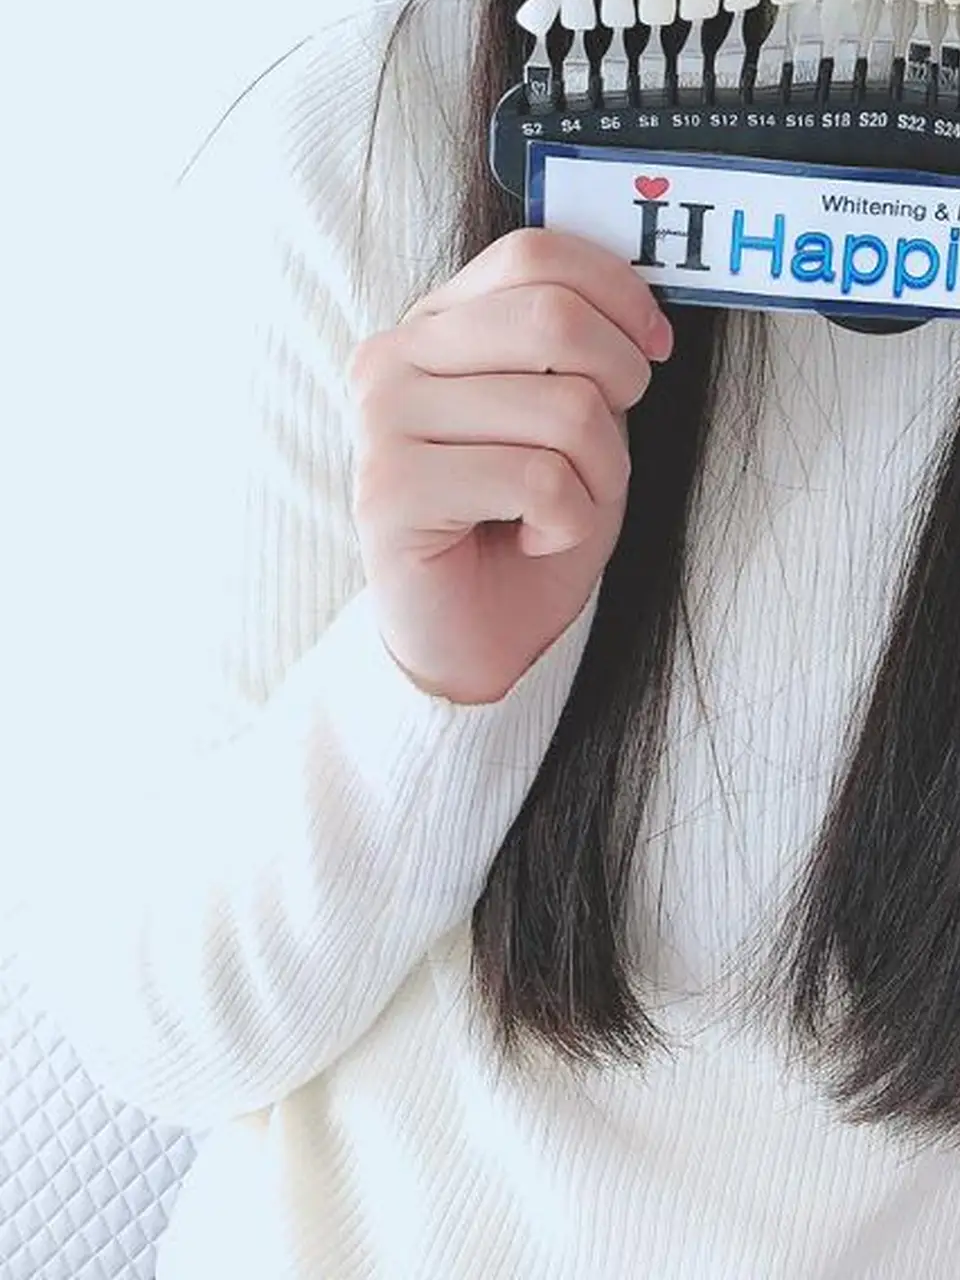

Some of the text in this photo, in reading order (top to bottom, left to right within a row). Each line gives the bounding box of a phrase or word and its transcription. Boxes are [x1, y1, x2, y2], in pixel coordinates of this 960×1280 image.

[522, 123, 542, 136] S2
[561, 119, 582, 133] S4
[600, 116, 621, 130] S6
[638, 114, 659, 128] S8
[672, 114, 701, 128] S10
[710, 114, 738, 127] S12
[747, 114, 776, 127] S14
[785, 114, 815, 128] S16
[822, 112, 851, 128] S18
[859, 112, 888, 127] S20
[897, 114, 926, 132] S22
[822, 194, 927, 222] Whitening
[934, 203, 951, 222] &
